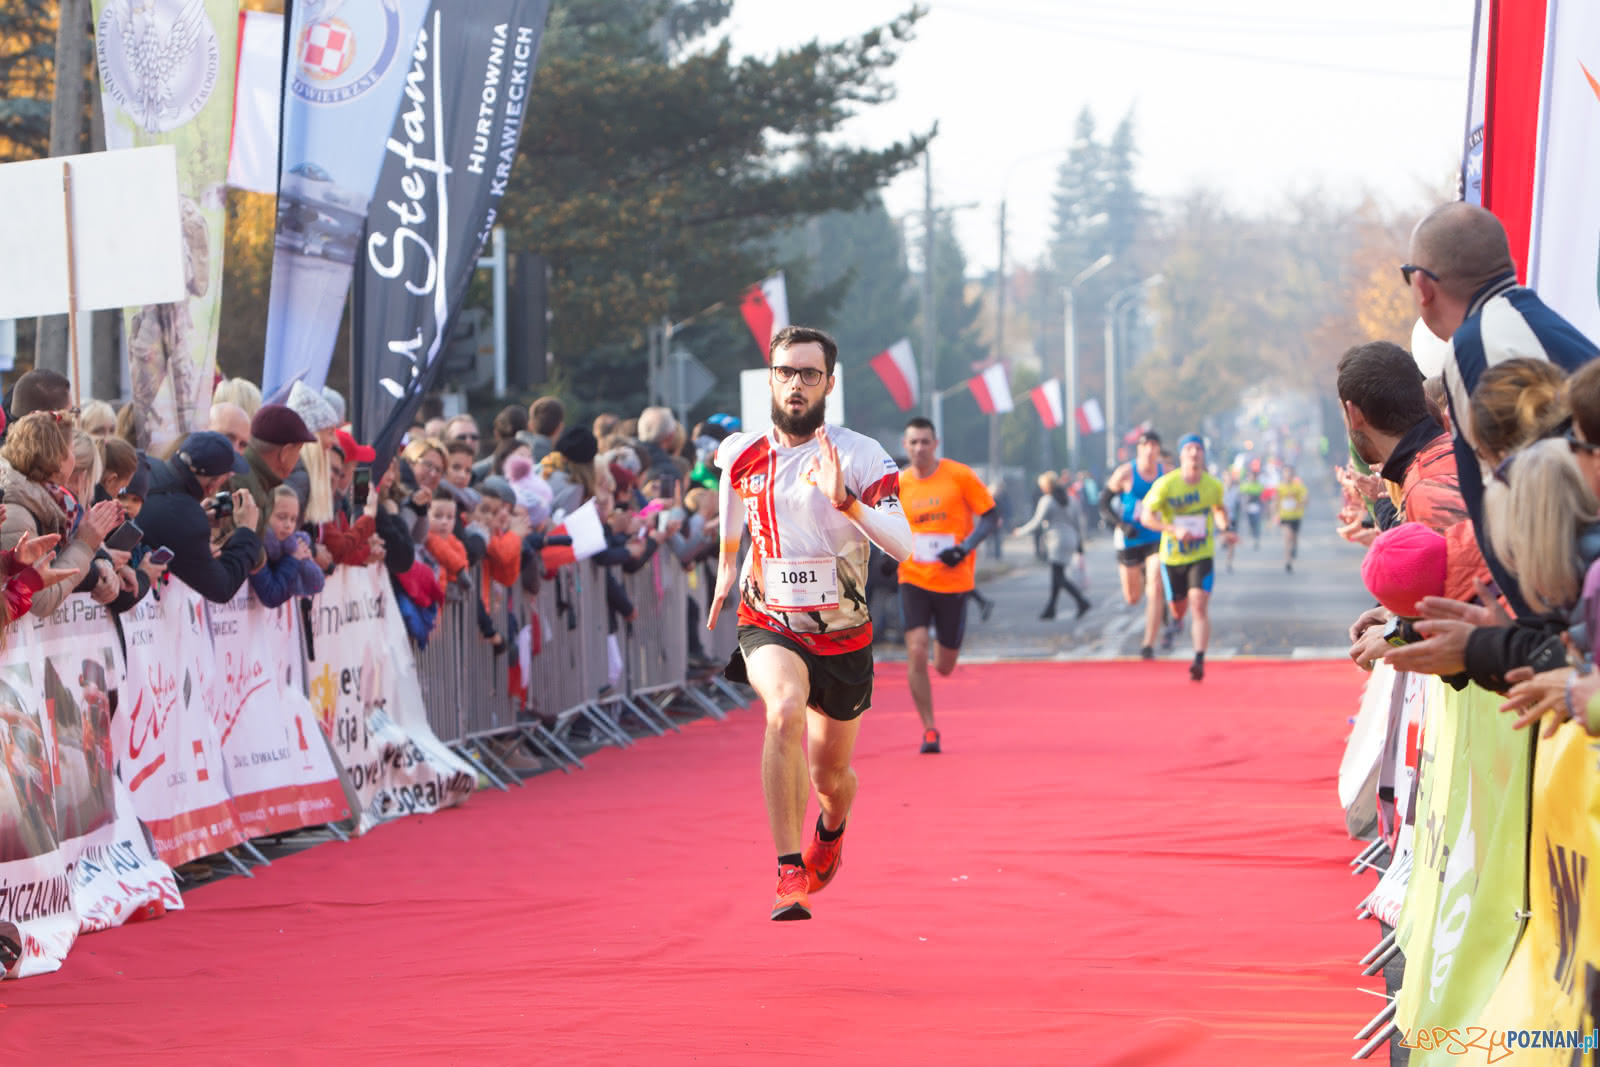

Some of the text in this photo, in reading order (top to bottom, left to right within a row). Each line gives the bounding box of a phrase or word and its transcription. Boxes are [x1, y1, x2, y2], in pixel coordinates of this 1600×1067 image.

[467, 23, 509, 174] HURTOWNIA
[490, 27, 533, 197] KRAWIECKICH
[781, 570, 818, 584] 1081
